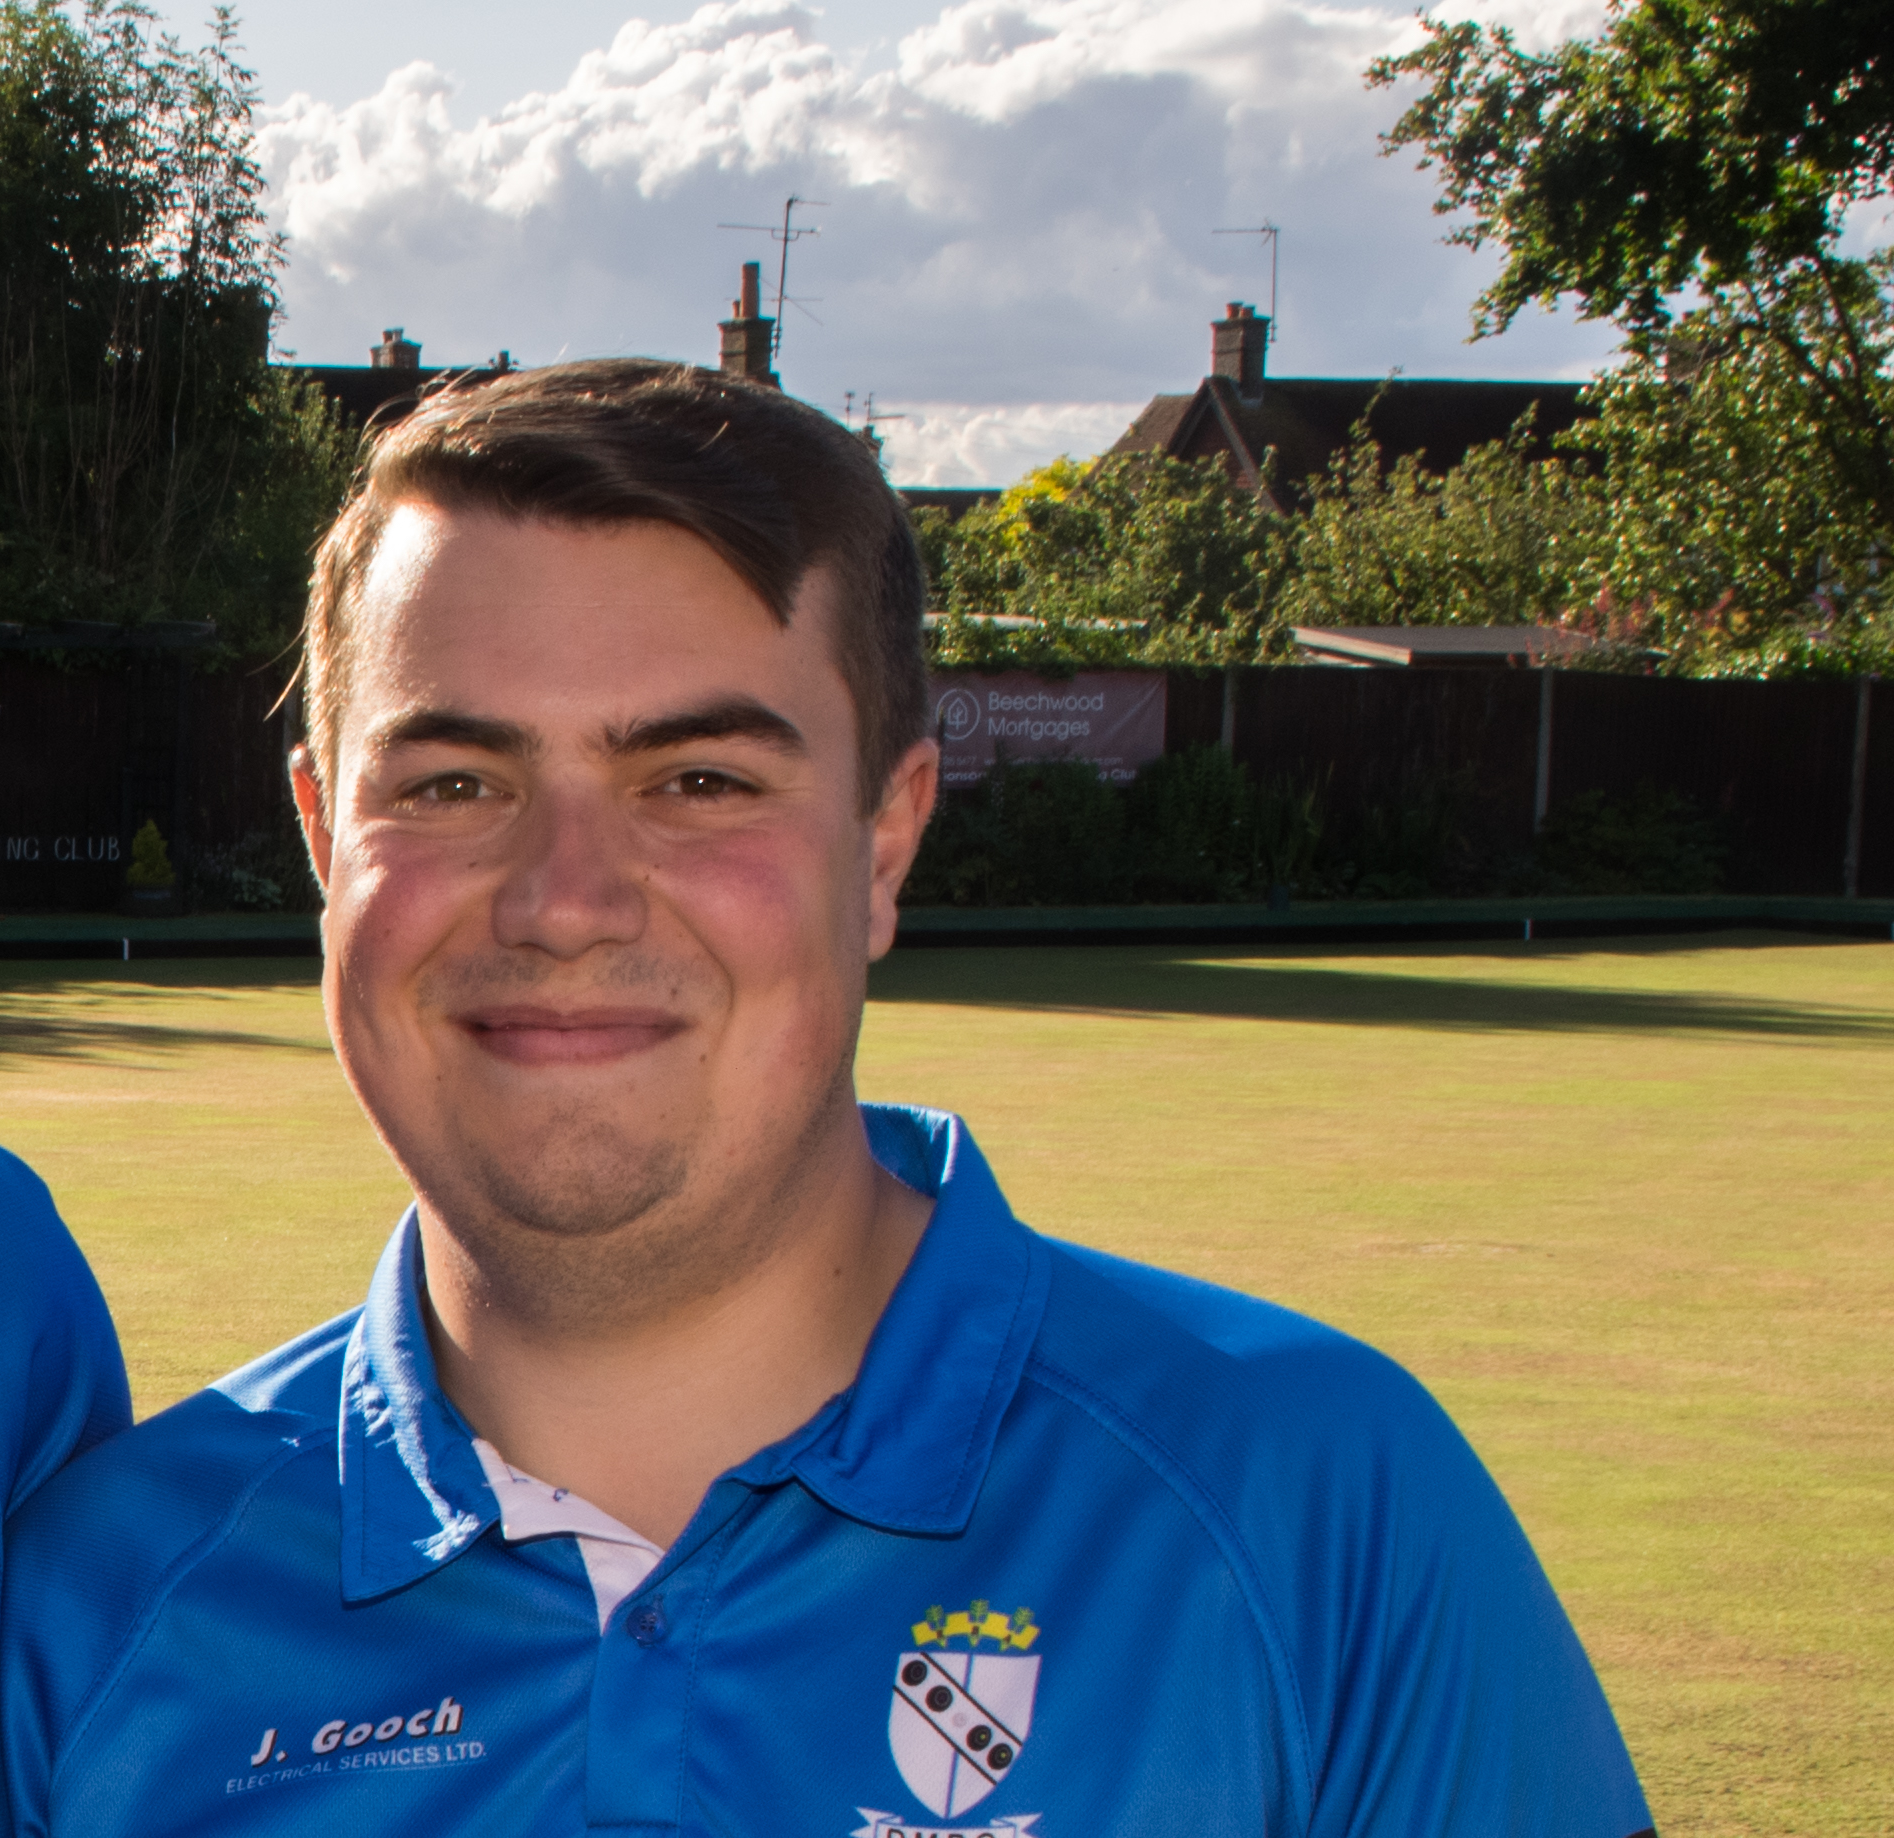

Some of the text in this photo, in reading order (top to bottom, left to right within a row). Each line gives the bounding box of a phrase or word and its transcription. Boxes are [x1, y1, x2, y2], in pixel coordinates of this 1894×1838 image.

[987, 691, 1104, 711] Beechwood
[987, 717, 1090, 741] Mortgages
[53, 836, 121, 861] CLUB
[251, 1696, 464, 1767] J. Gooch
[225, 1741, 487, 1794] ELECTRICAL SERVICES LTD.
